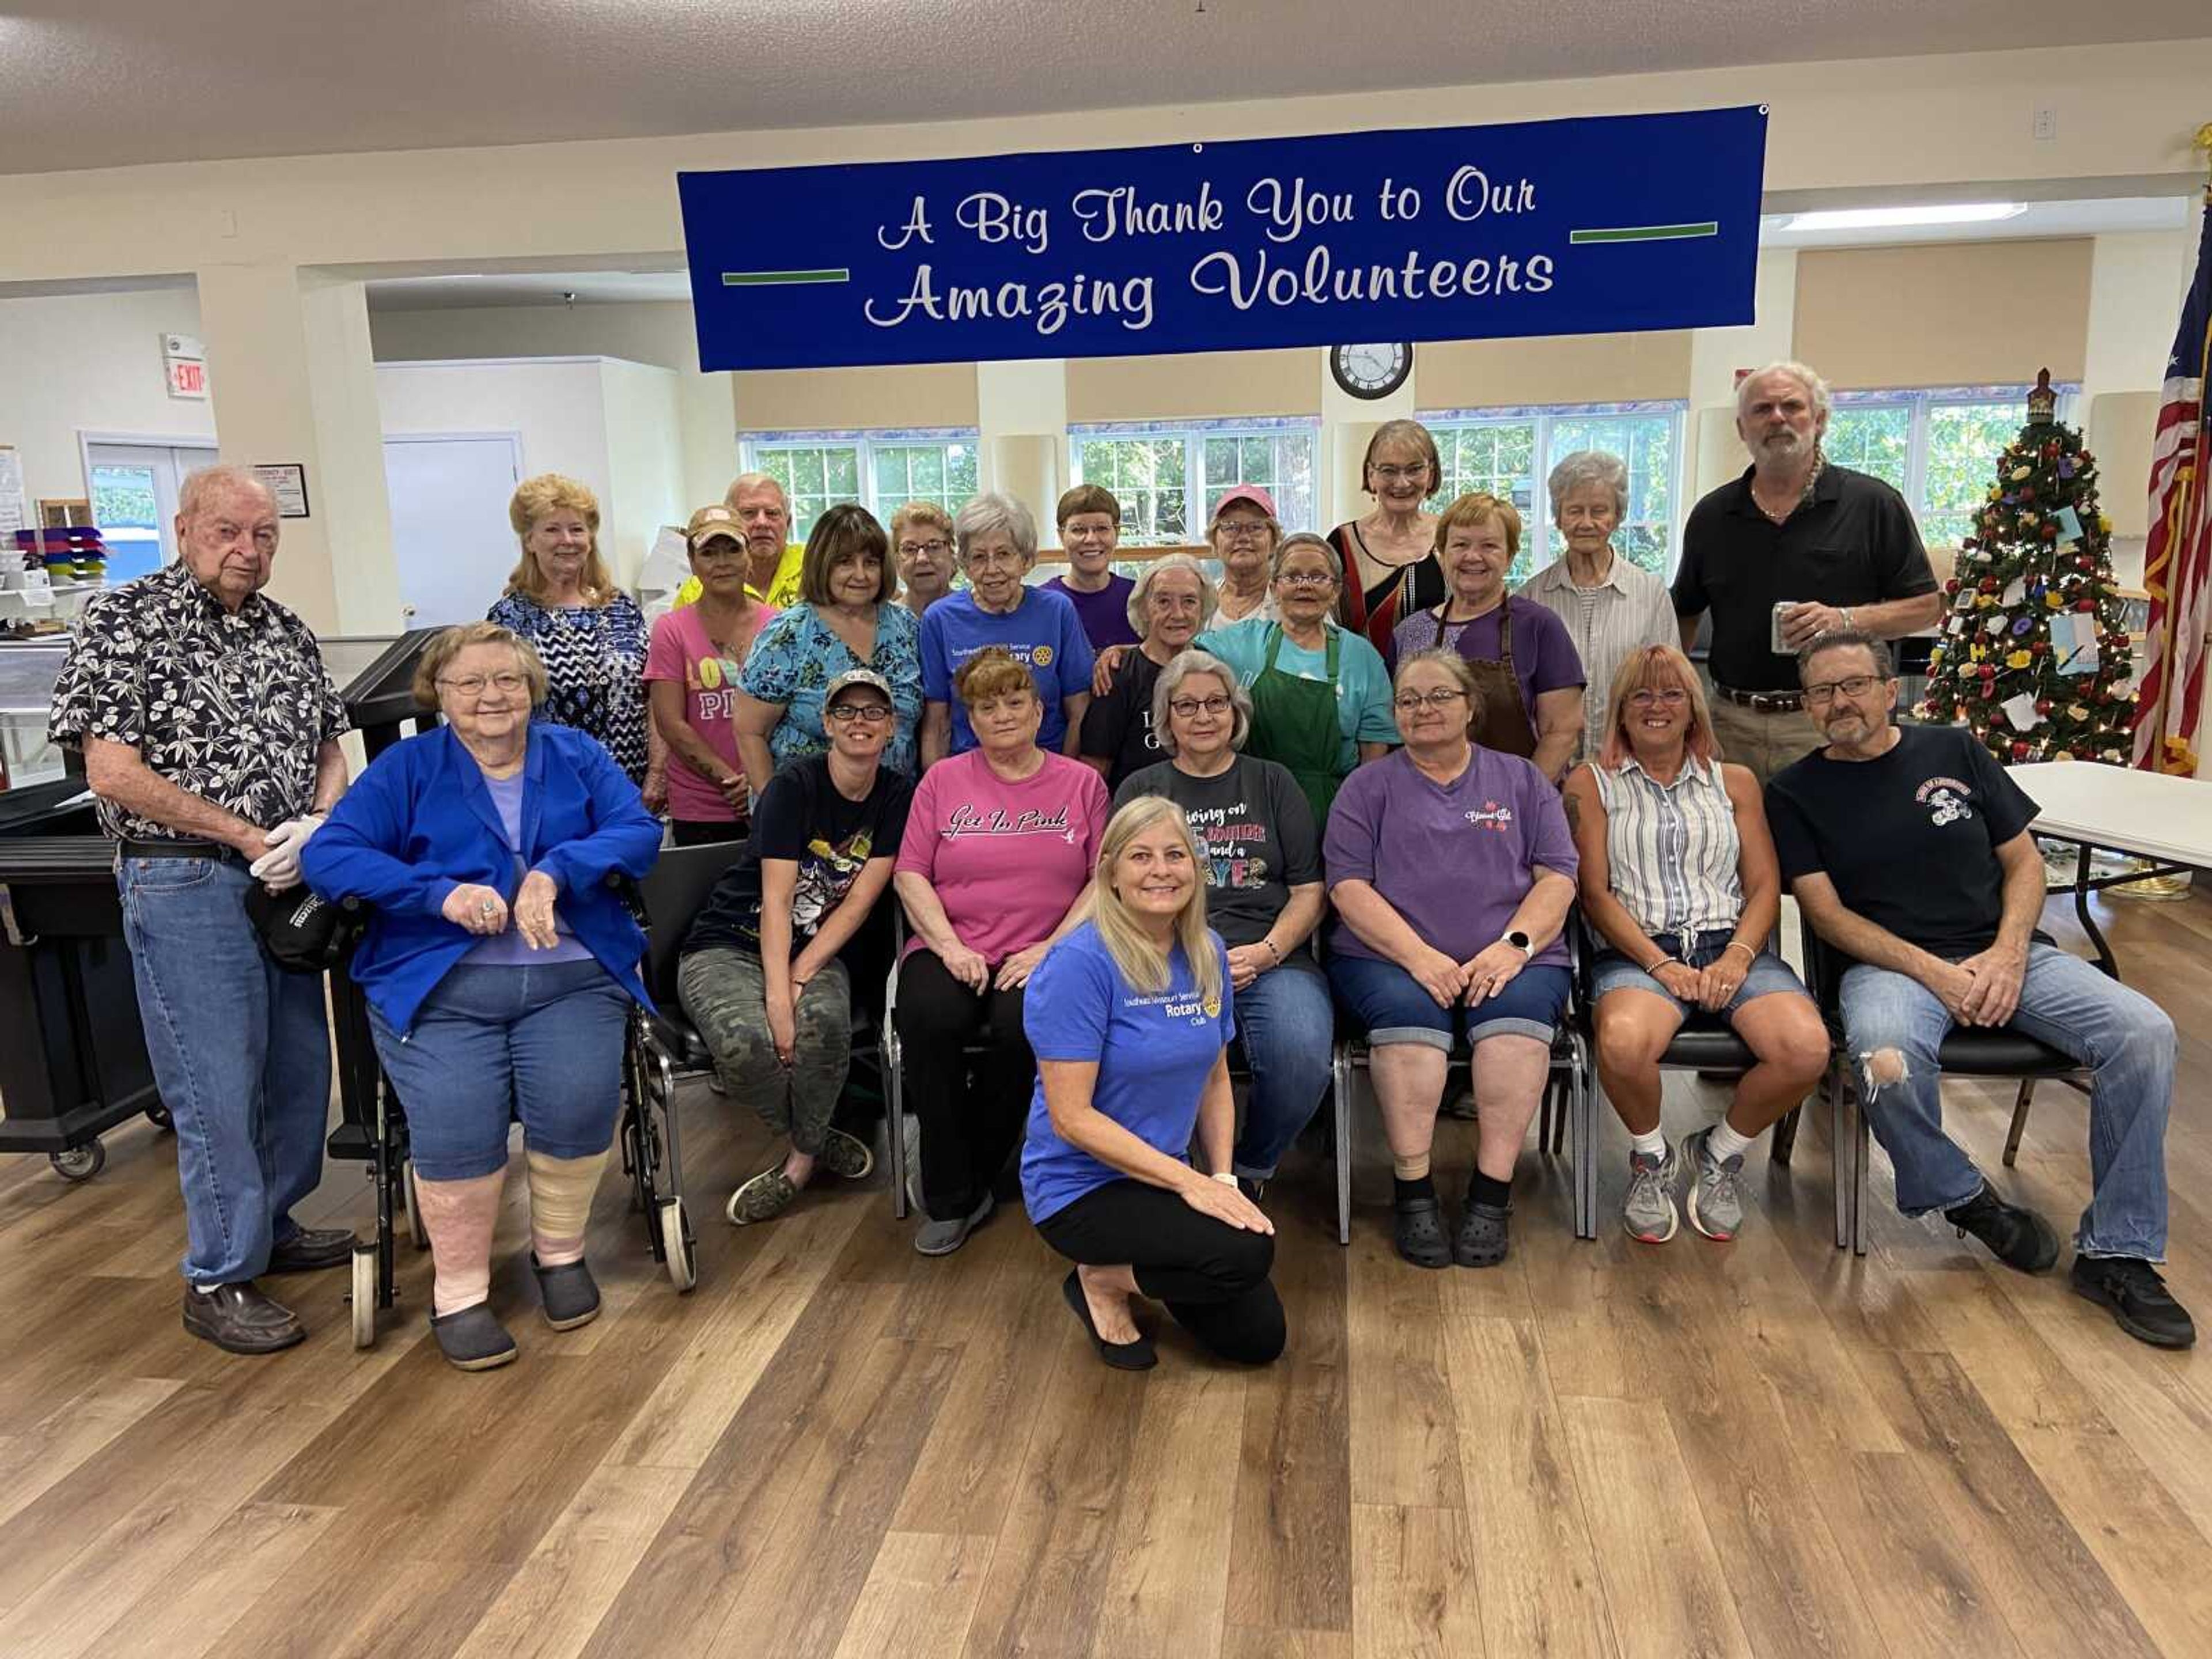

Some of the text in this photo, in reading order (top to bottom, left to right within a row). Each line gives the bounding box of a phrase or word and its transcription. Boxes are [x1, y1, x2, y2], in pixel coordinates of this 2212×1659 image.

[878, 166, 1535, 253] A Big Thank You to Our
[865, 245, 1553, 334] Amazing Volunteers
[177, 364, 202, 392] EXIT
[699, 689, 736, 720] PI
[1017, 806, 1067, 832] Pink
[1185, 802, 1247, 827] iving on
[1210, 840, 1233, 858] and
[1165, 1003, 1201, 1018] Rotary
